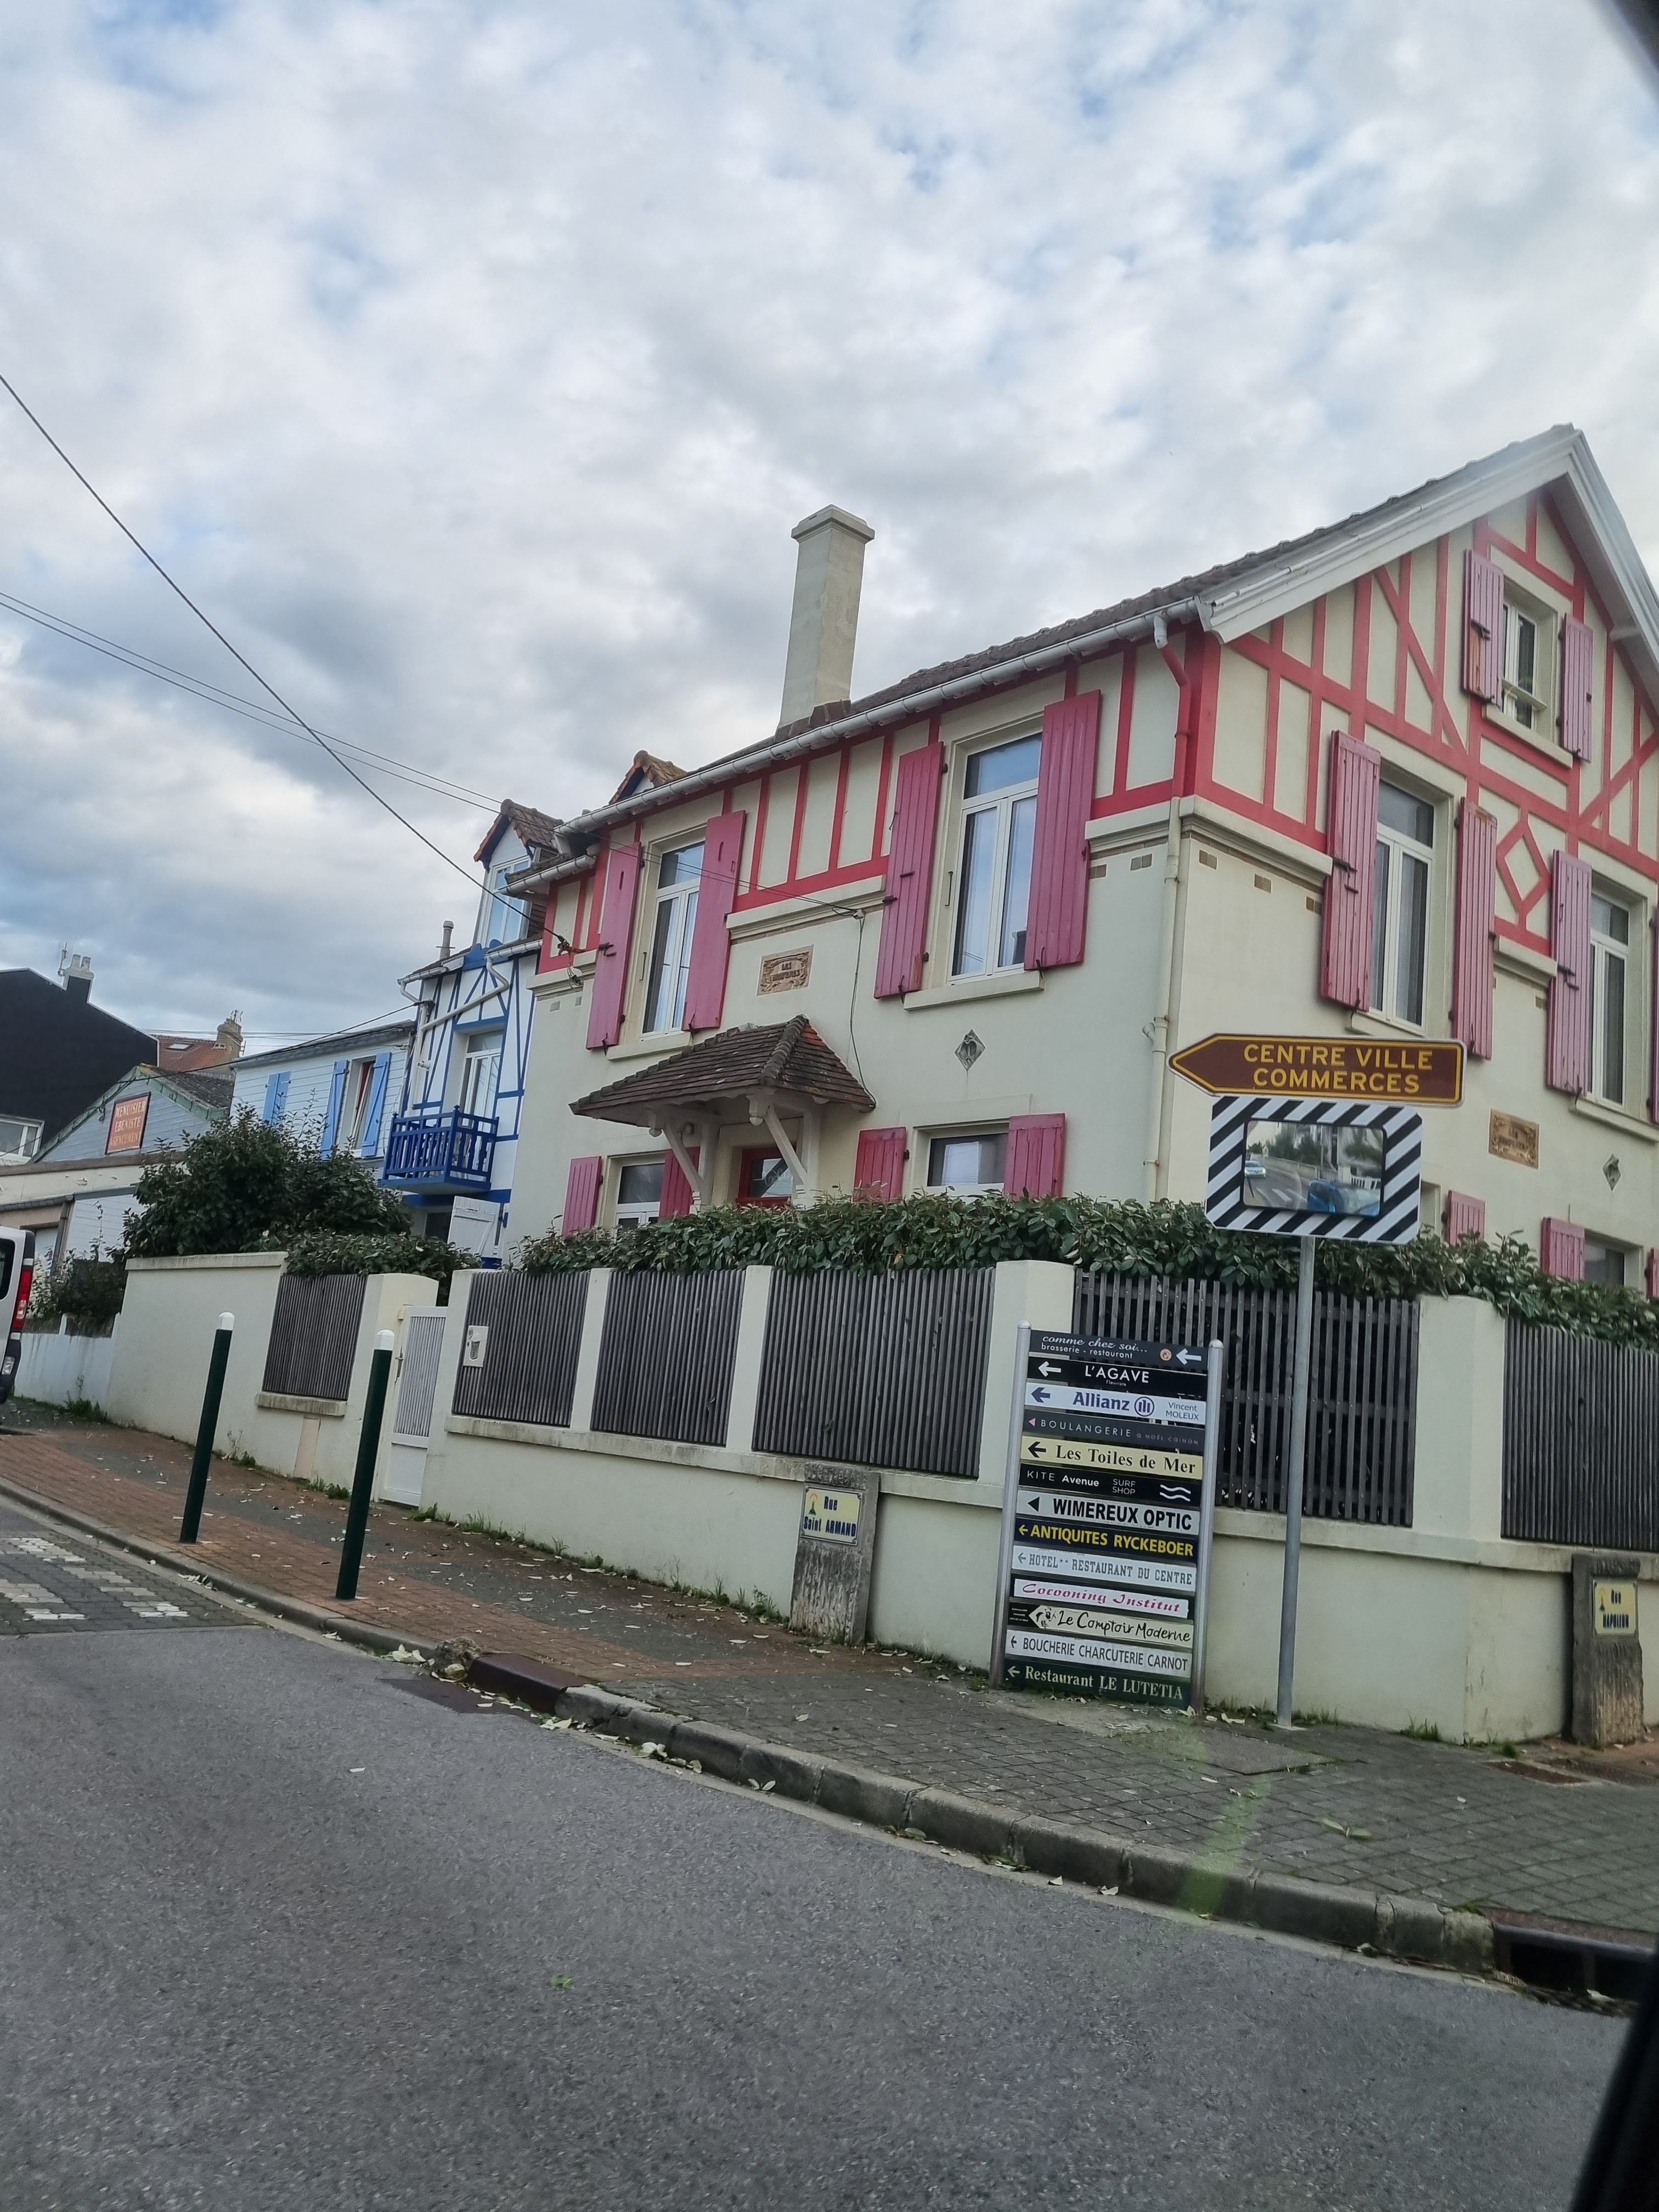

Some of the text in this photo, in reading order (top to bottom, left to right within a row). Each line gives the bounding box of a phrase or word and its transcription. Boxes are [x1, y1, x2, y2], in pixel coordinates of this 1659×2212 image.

[1244, 1043, 1433, 1071] CENTRE VILLE
[1253, 1068, 1420, 1094] COMMERCES
[115, 1101, 146, 1119] MENUISIER
[1041, 1342, 1133, 1359] brasserie restaurant
[1042, 1336, 1085, 1345] comme
[1088, 1337, 1116, 1348] chez
[1085, 1365, 1149, 1384] L'AGAVE
[1073, 1391, 1130, 1411] Allianz
[1168, 1401, 1198, 1412] Vincent
[1165, 1409, 1199, 1421] MOLEUX
[1041, 1419, 1131, 1437] BOULANGERIE
[1056, 1444, 1195, 1474] Les Toiles de Mer
[1027, 1470, 1099, 1487] KITE Avenue
[1113, 1479, 1136, 1488] SURF
[1112, 1486, 1136, 1496] SHOP
[824, 1496, 838, 1511] Rue
[1053, 1498, 1192, 1531] WIMEREUX OPTIC
[803, 1516, 856, 1537] Saint ARMAND
[1030, 1524, 1194, 1557] ANTIQUITES RYCKEBOER
[1029, 1553, 1192, 1585] HOTEL RESTAURANT DU CENTRE
[1023, 1583, 1181, 1613] Cocooning Institut
[1058, 1610, 1191, 1642] Le Comptoir Moderne
[1023, 1637, 1188, 1672] BOUCHERIE CHARCUTERIE CARNOT
[1025, 1666, 1183, 1701] Restaurant LE LUTETIA
